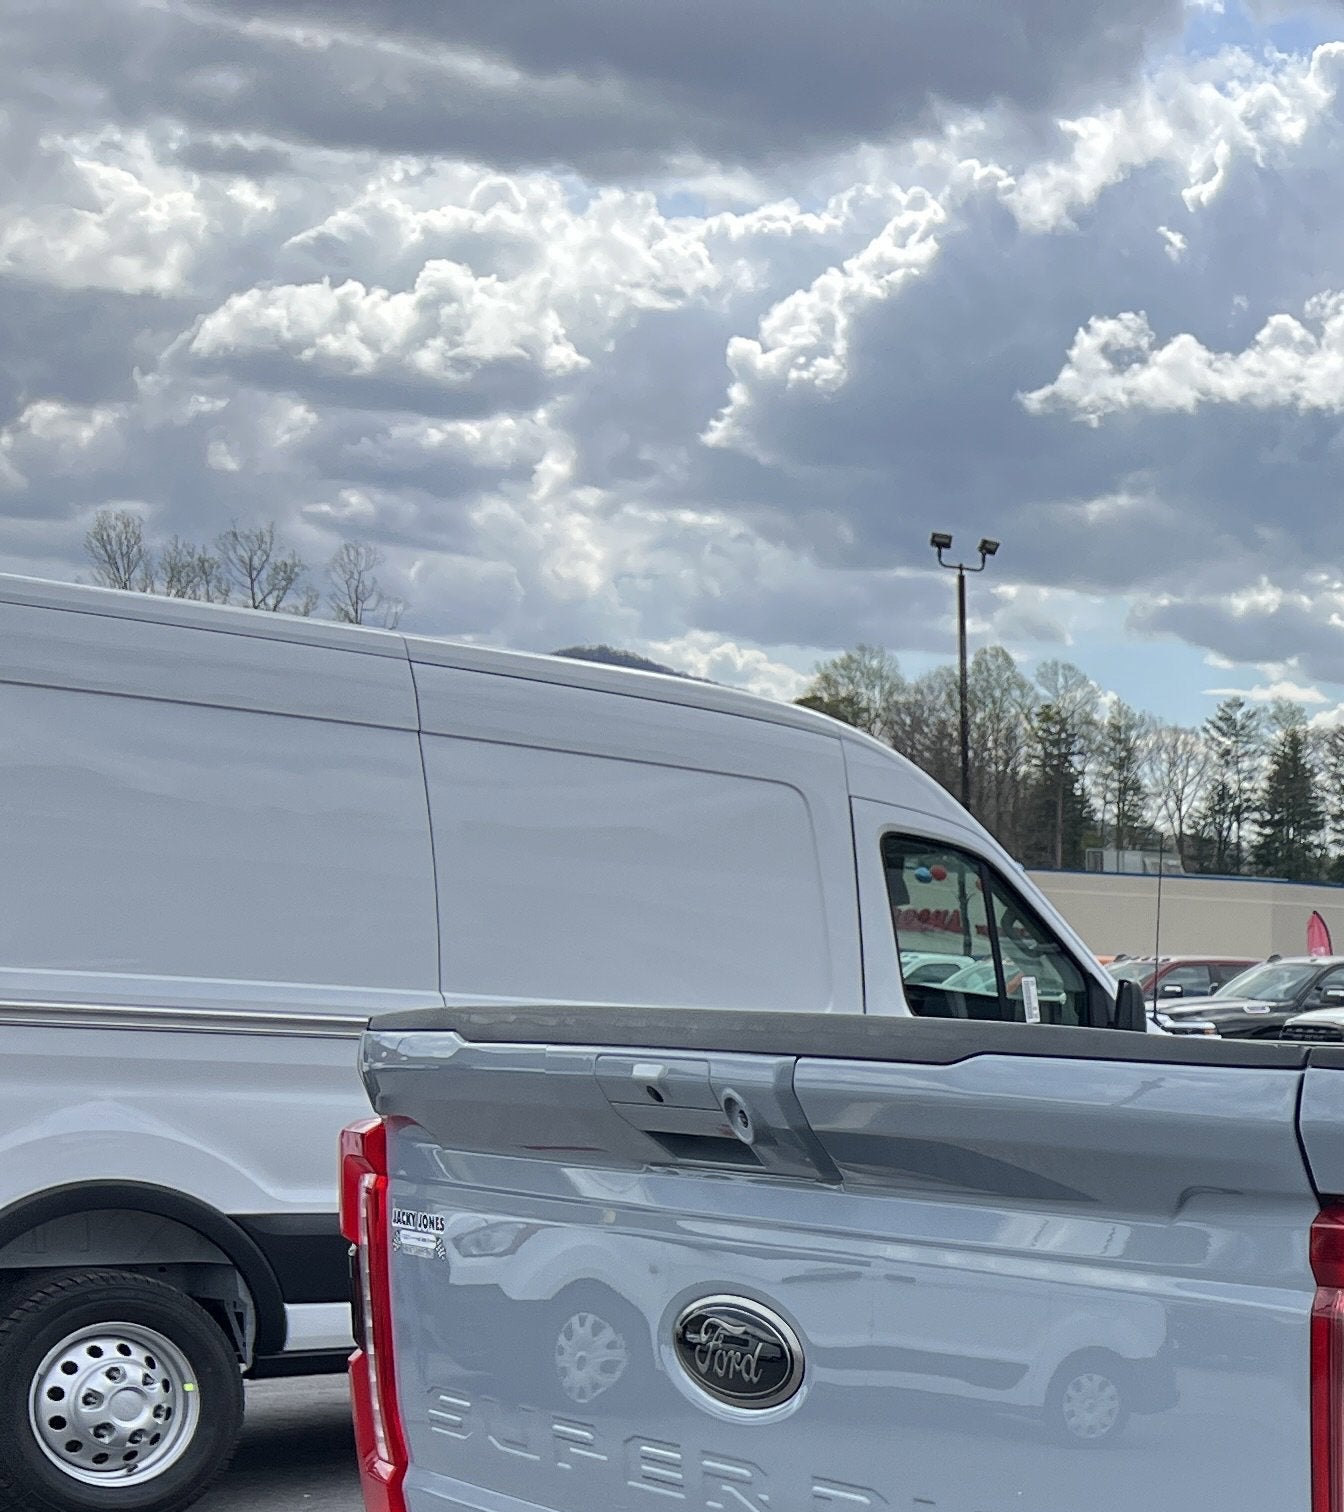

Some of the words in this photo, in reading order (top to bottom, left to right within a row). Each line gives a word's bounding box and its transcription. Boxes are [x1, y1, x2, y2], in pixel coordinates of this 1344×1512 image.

[392, 1210, 416, 1226] JACKY
[418, 1214, 445, 1231] JONES
[695, 1318, 763, 1384] Ford
